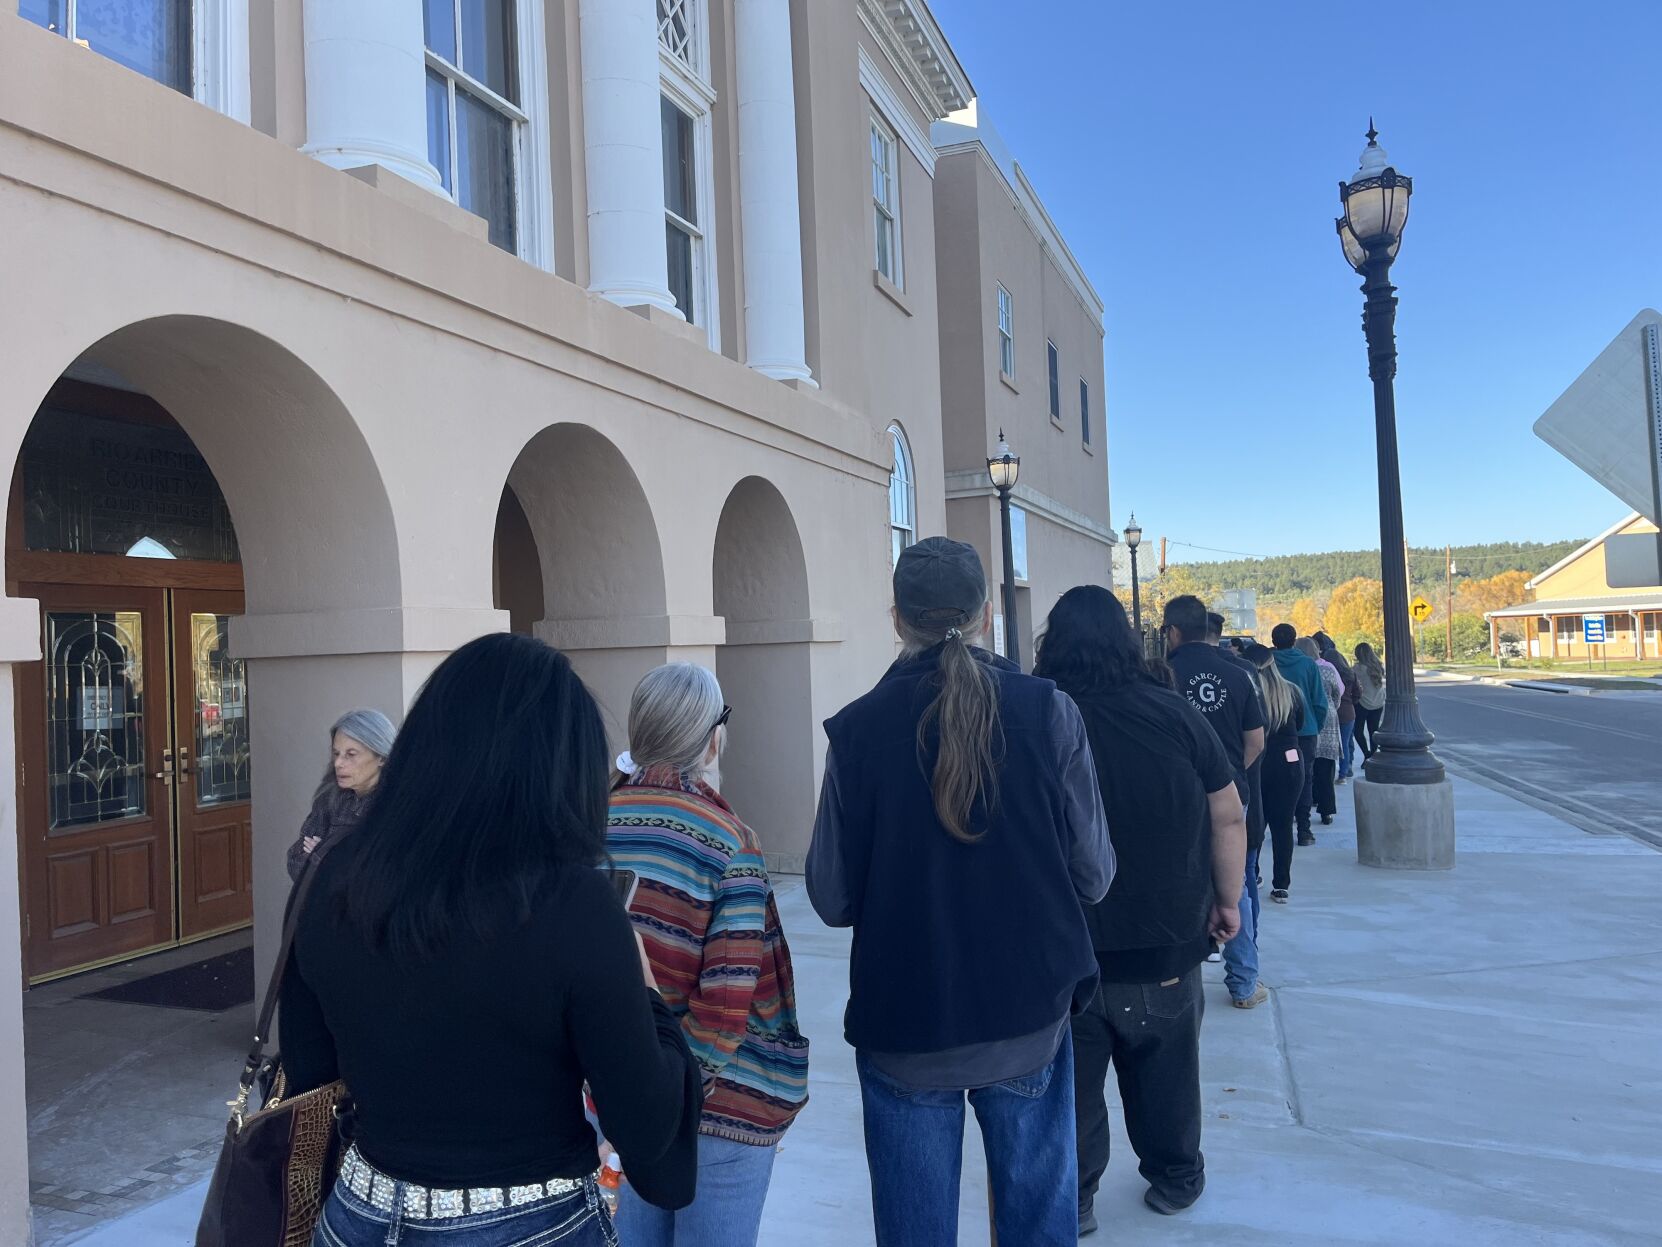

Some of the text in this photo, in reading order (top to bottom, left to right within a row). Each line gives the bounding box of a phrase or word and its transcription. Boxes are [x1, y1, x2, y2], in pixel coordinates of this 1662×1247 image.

[91, 439, 130, 460] RIO
[105, 469, 199, 496] COUNTY
[93, 495, 209, 519] COURTHOUSE
[1190, 673, 1222, 685] GARCIA
[1187, 691, 1201, 710] LAND
[1208, 688, 1227, 712] CATTLE
[1199, 683, 1215, 702] G
